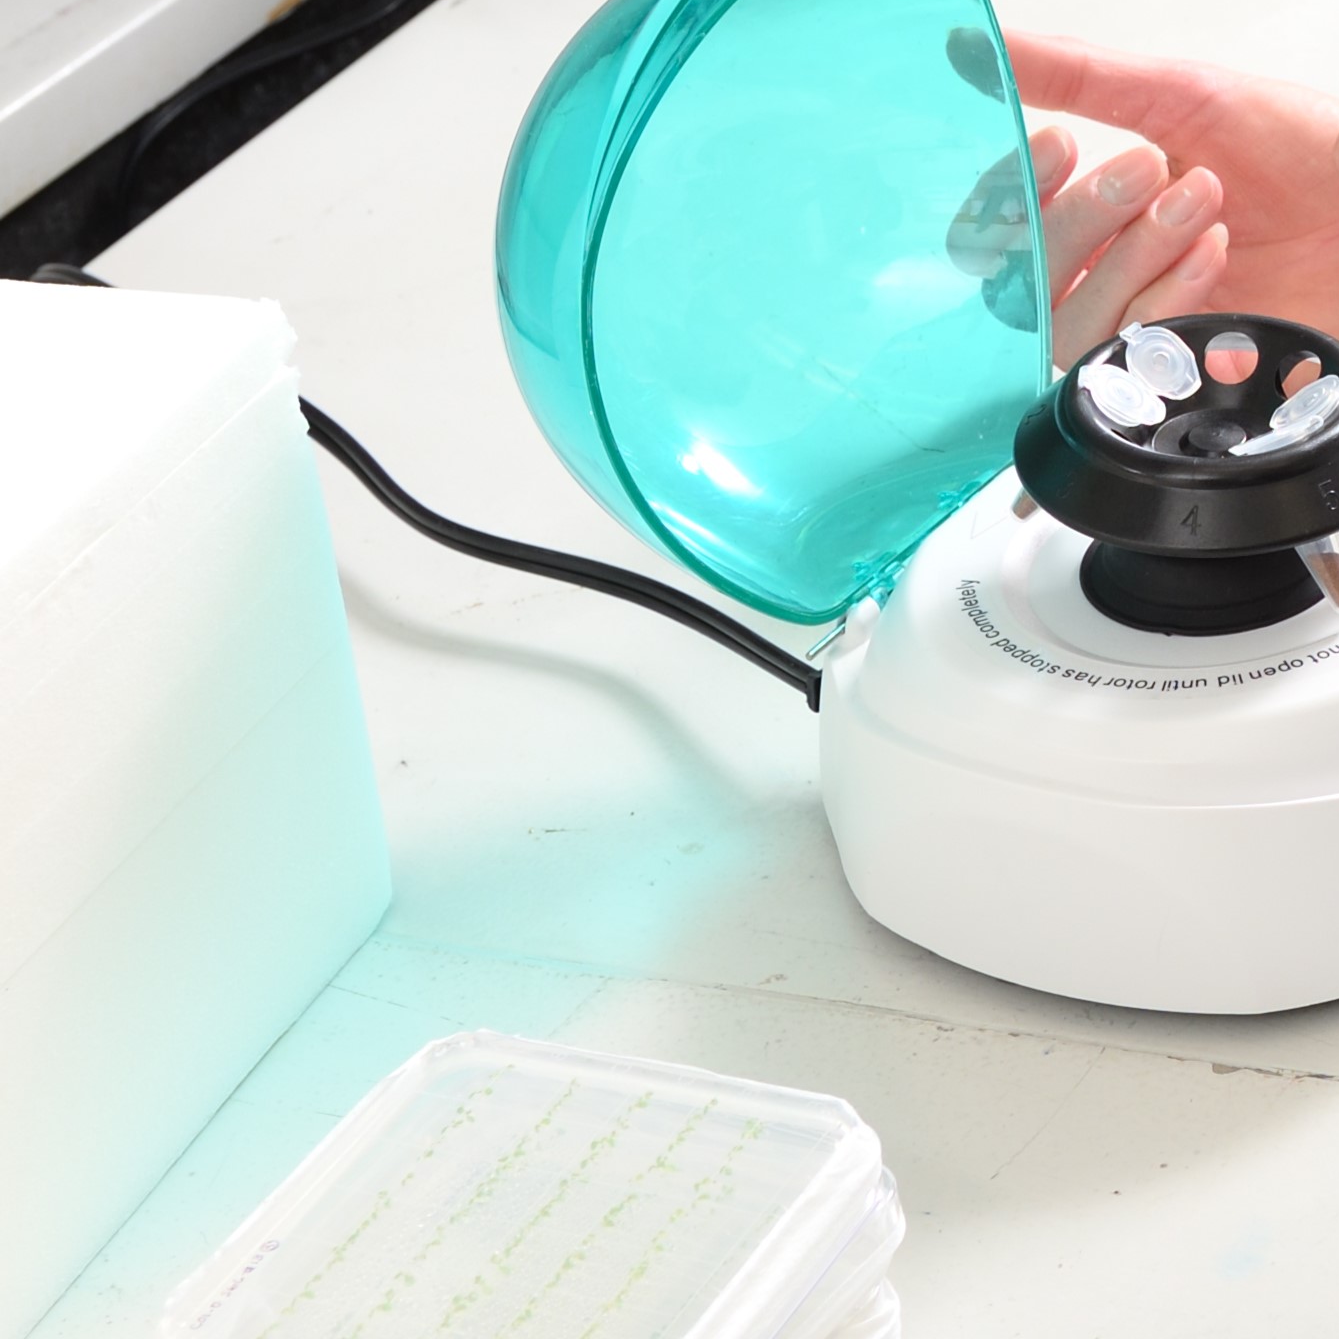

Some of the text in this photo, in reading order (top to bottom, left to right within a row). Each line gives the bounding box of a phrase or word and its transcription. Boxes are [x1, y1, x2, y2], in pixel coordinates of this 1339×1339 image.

[1179, 504, 1202, 537] 4
[955, 578, 1000, 640] completely
[990, 636, 1061, 673] stopped
[1061, 667, 1102, 688] has
[1248, 657, 1304, 680] open
[1103, 675, 1156, 691] rotor
[1161, 677, 1208, 692] until
[1217, 673, 1244, 688] lid
